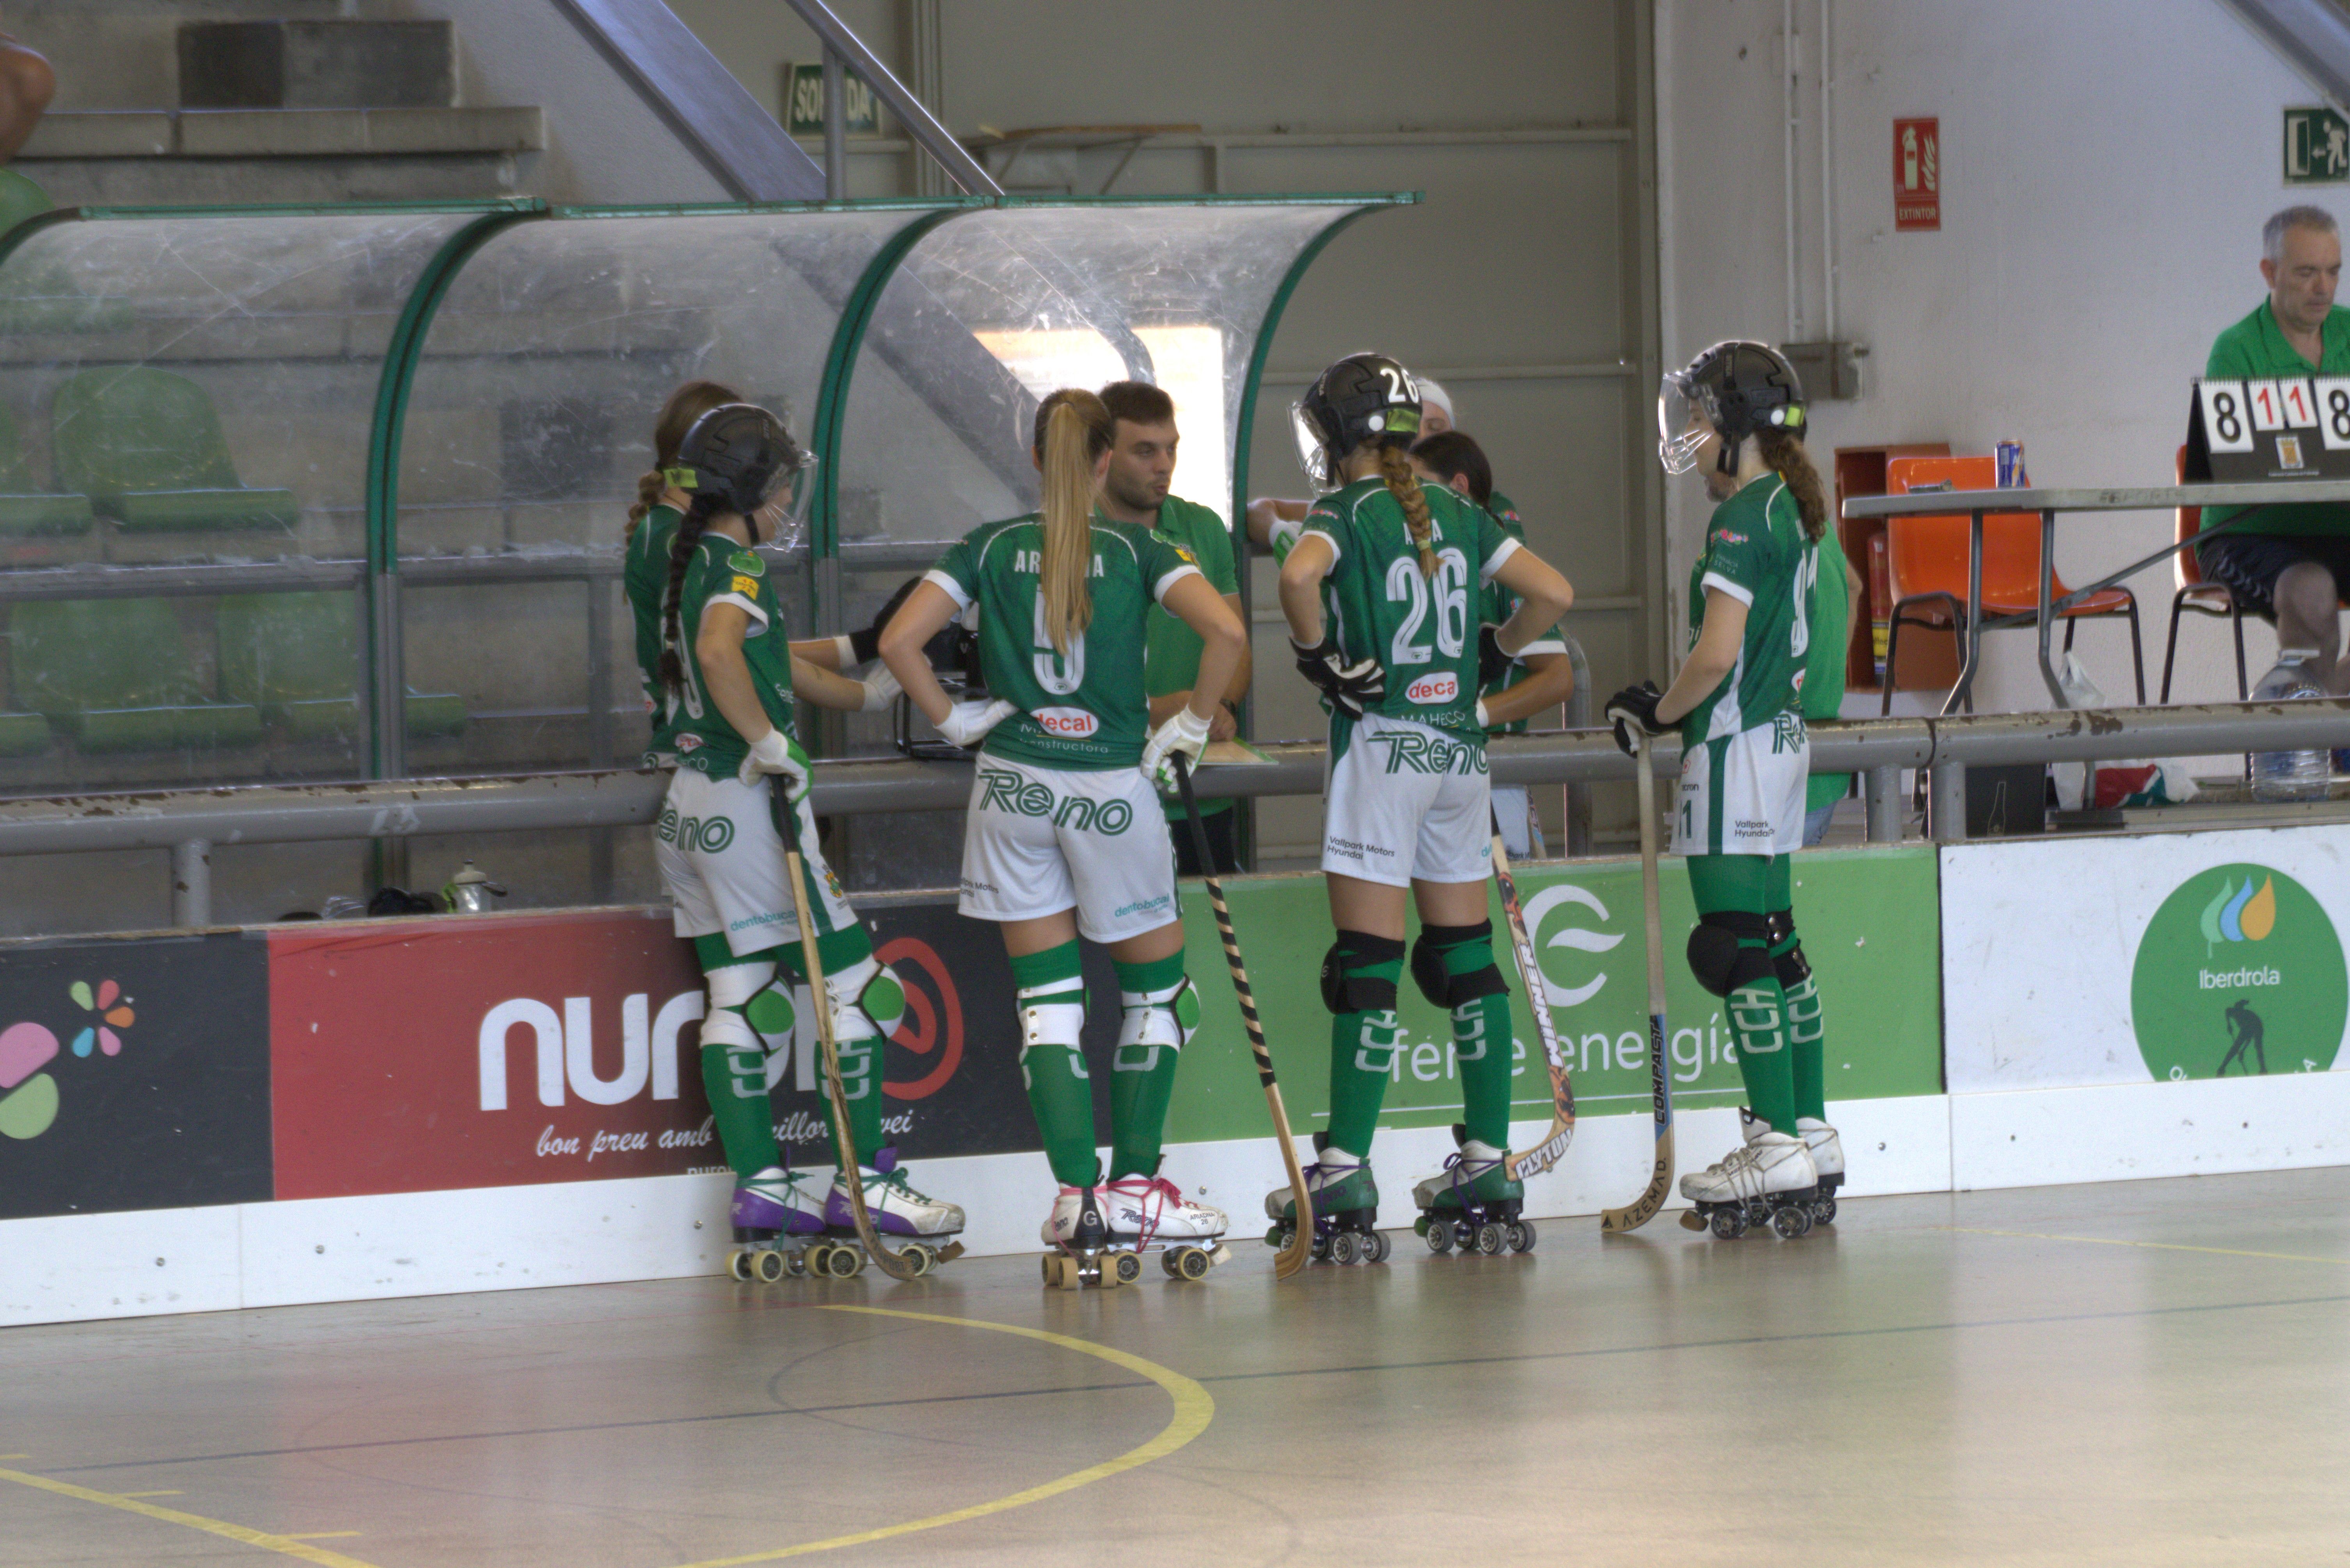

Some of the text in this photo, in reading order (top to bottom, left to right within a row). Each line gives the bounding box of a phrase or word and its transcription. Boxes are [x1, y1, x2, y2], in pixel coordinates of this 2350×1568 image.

[1899, 207, 1936, 220] EXTINTOR
[1380, 368, 1419, 403] 26
[2213, 385, 2350, 444] 8 1 1 8
[1386, 547, 1467, 665] 26
[1408, 680, 1455, 699] deca
[978, 769, 1133, 836] Reno
[657, 809, 735, 853] eno
[1735, 820, 1768, 830] Vallpark
[1327, 844, 1364, 860] Hyundai
[1329, 835, 1395, 857] Vallpark Motors
[1115, 893, 1170, 917] dentobucal
[2199, 965, 2281, 989] Iberdrola
[1649, 1015, 1666, 1125] COMPACT
[536, 1124, 580, 1157] bon
[587, 1132, 649, 1162] preu
[658, 1115, 714, 1148] amb
[1083, 1210, 1098, 1226] G
[1190, 1211, 1215, 1220] ARIADNA
